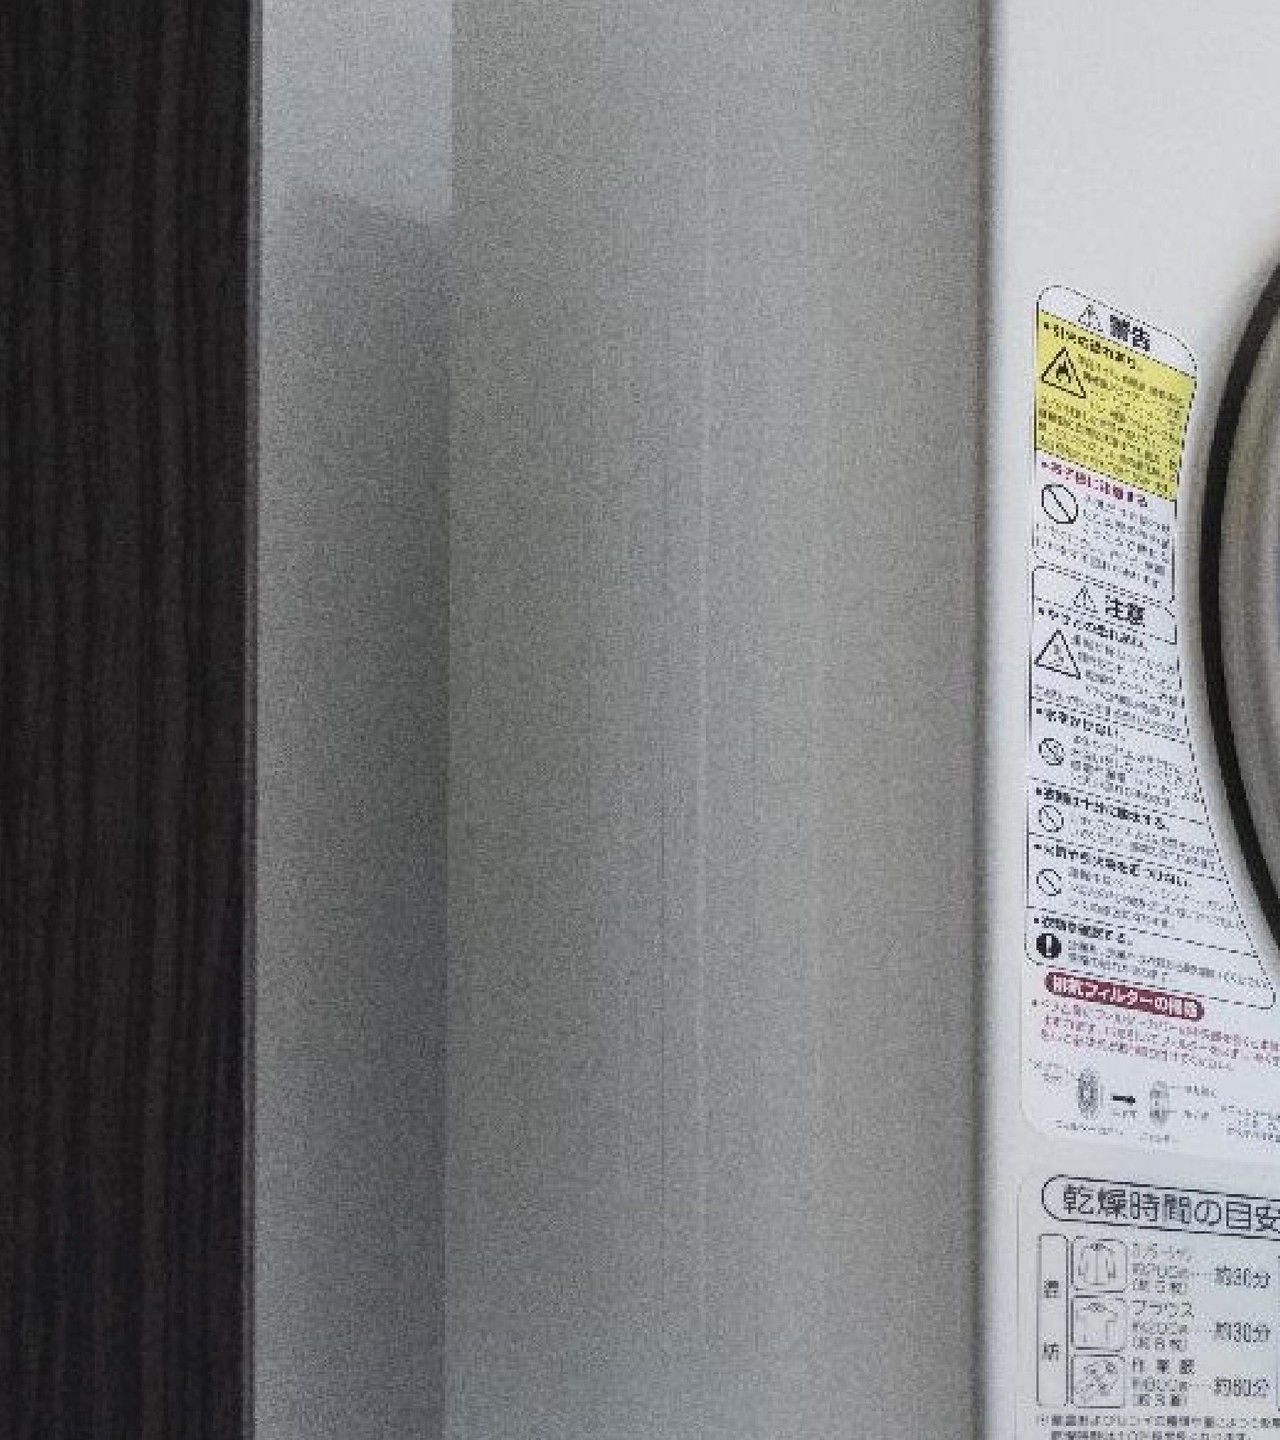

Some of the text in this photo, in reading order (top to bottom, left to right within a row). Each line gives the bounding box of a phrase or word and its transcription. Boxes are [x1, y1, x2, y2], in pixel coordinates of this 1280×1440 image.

[1063, 1184, 1280, 1234] 乾燥時間の目安
